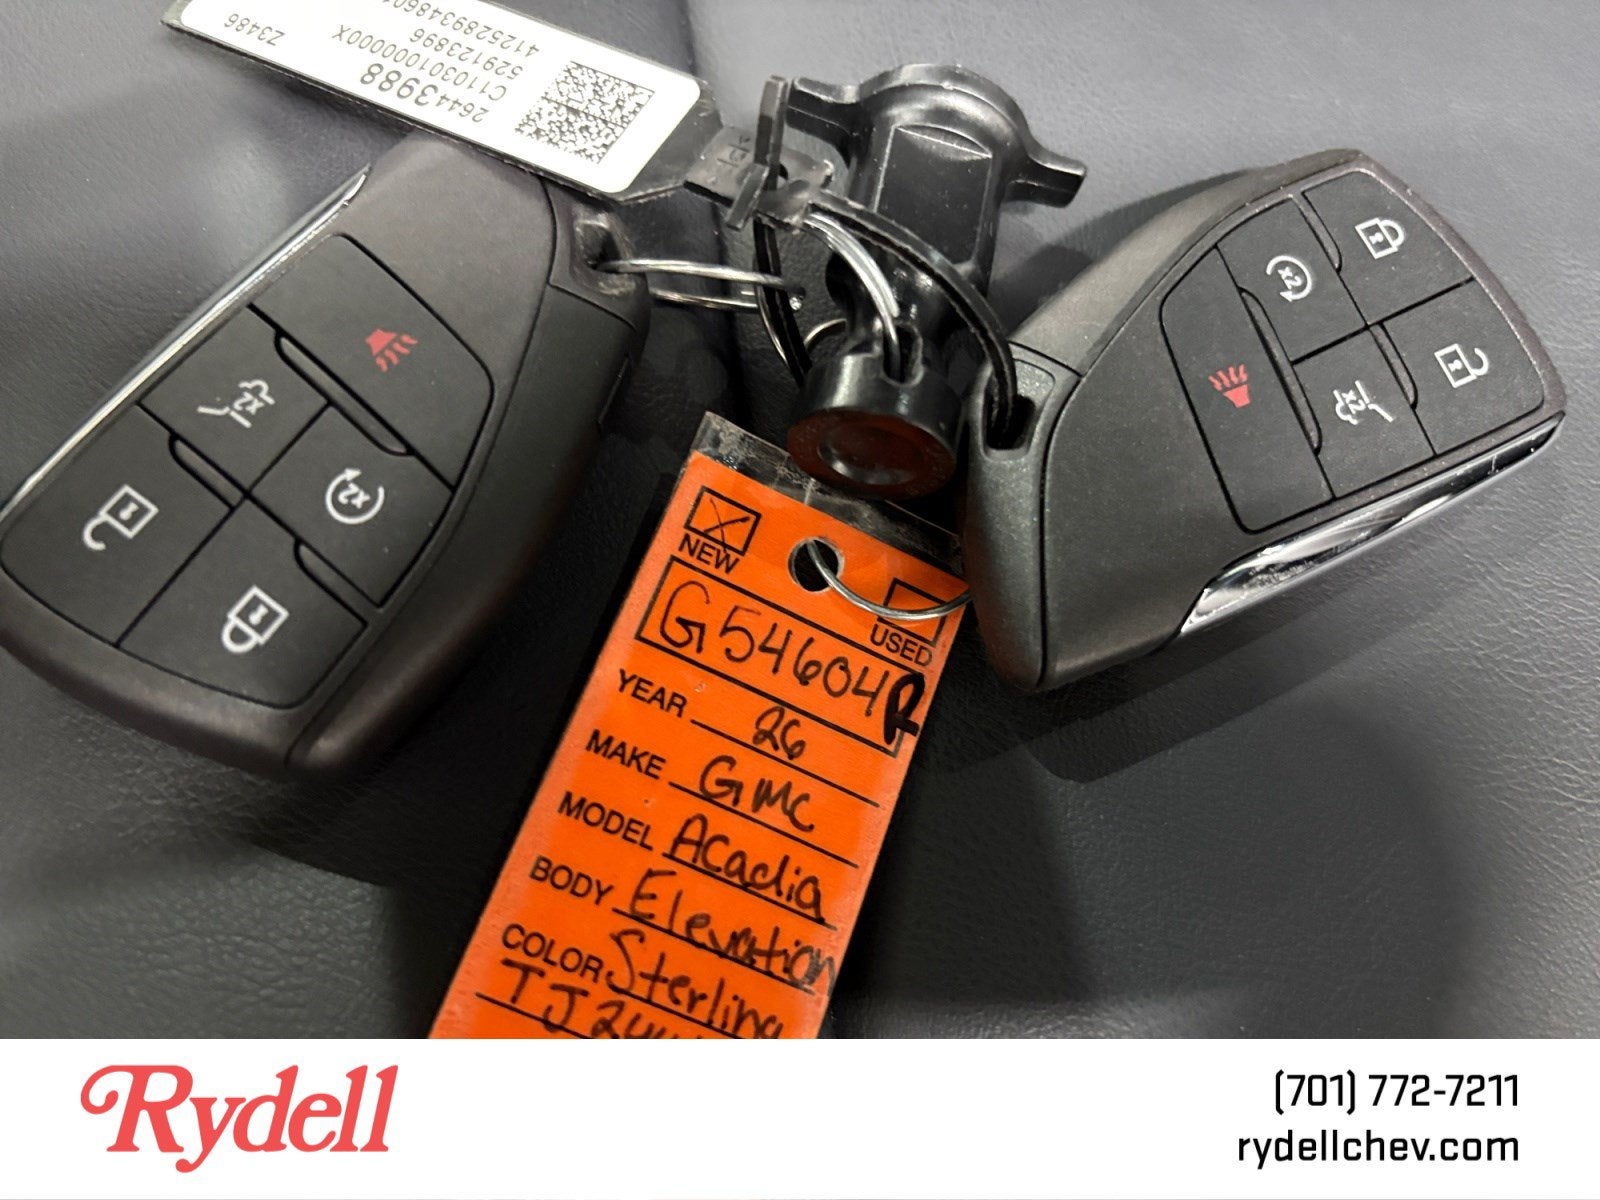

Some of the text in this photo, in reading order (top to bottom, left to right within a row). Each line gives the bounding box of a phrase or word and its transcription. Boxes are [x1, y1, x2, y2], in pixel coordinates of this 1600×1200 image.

[223, 13, 285, 46] Z3486
[383, 0, 540, 57] 412528934860
[409, 28, 523, 80] 529123896
[332, 24, 507, 101] C110301000000X
[360, 63, 489, 123] 26443988
[678, 533, 740, 574] NEW
[869, 624, 934, 667] USED
[618, 668, 688, 718] YEAR
[585, 728, 667, 781] MAKE
[752, 705, 807, 761] 26
[557, 790, 654, 852] MODEL
[529, 854, 615, 906] BODY
[501, 922, 605, 985] COLOR
[629, 868, 836, 999] Elevation
